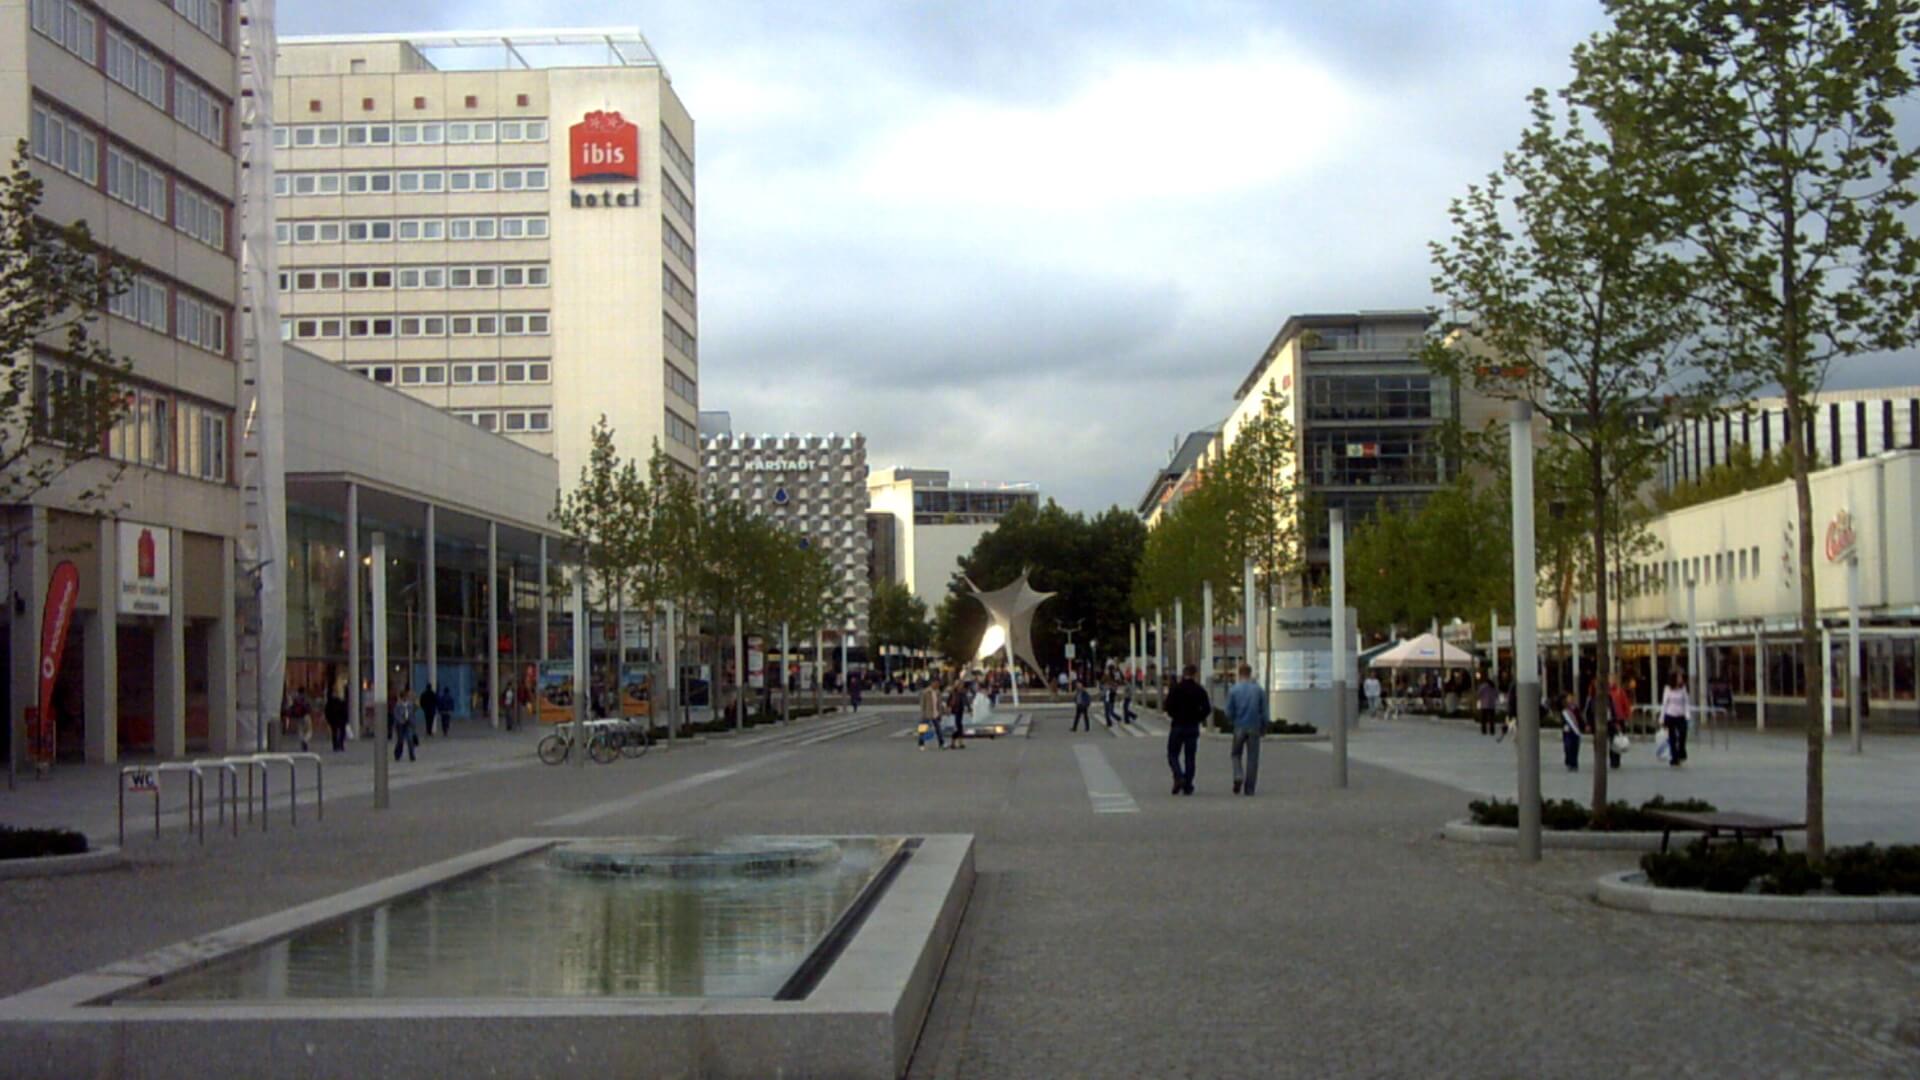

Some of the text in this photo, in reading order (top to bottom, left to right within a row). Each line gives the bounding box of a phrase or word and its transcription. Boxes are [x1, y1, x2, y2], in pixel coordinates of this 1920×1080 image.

[582, 142, 625, 165] ibis
[570, 187, 640, 208] hotel
[744, 459, 816, 472] KARSTADT
[132, 771, 155, 786] WC
